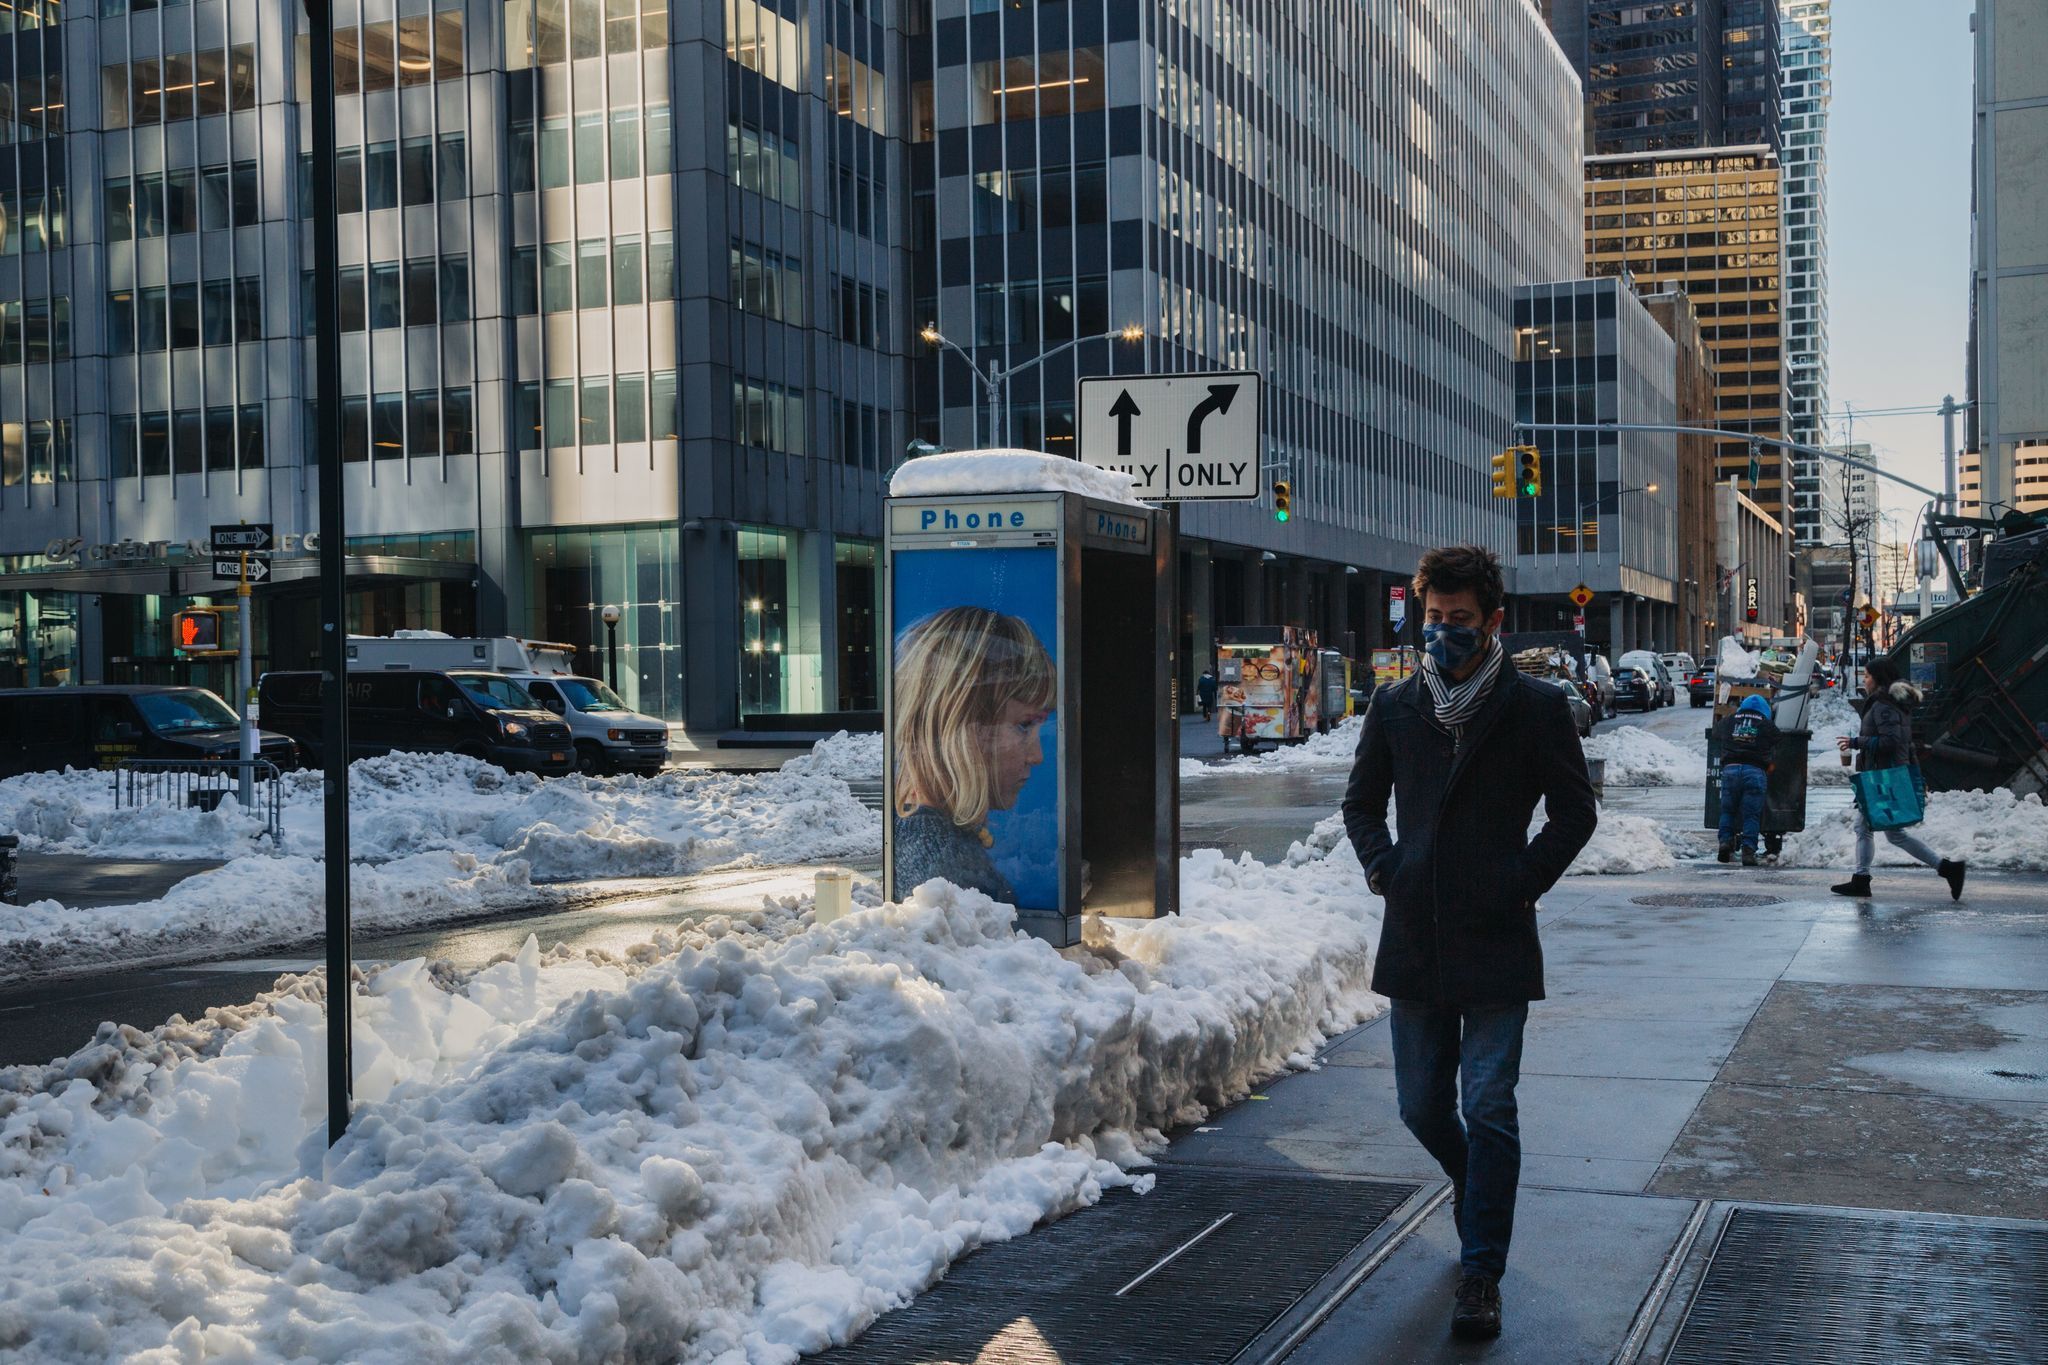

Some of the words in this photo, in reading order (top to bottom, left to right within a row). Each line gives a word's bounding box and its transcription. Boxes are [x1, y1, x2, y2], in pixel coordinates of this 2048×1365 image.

[1178, 462, 1248, 487] ONLY
[921, 509, 1025, 530] Phone
[1098, 514, 1138, 539] Phone
[220, 533, 237, 543] ONE
[245, 532, 263, 542] WAY
[221, 563, 238, 574] ONE
[246, 565, 262, 575] WAY
[1748, 579, 1757, 606] PARK
